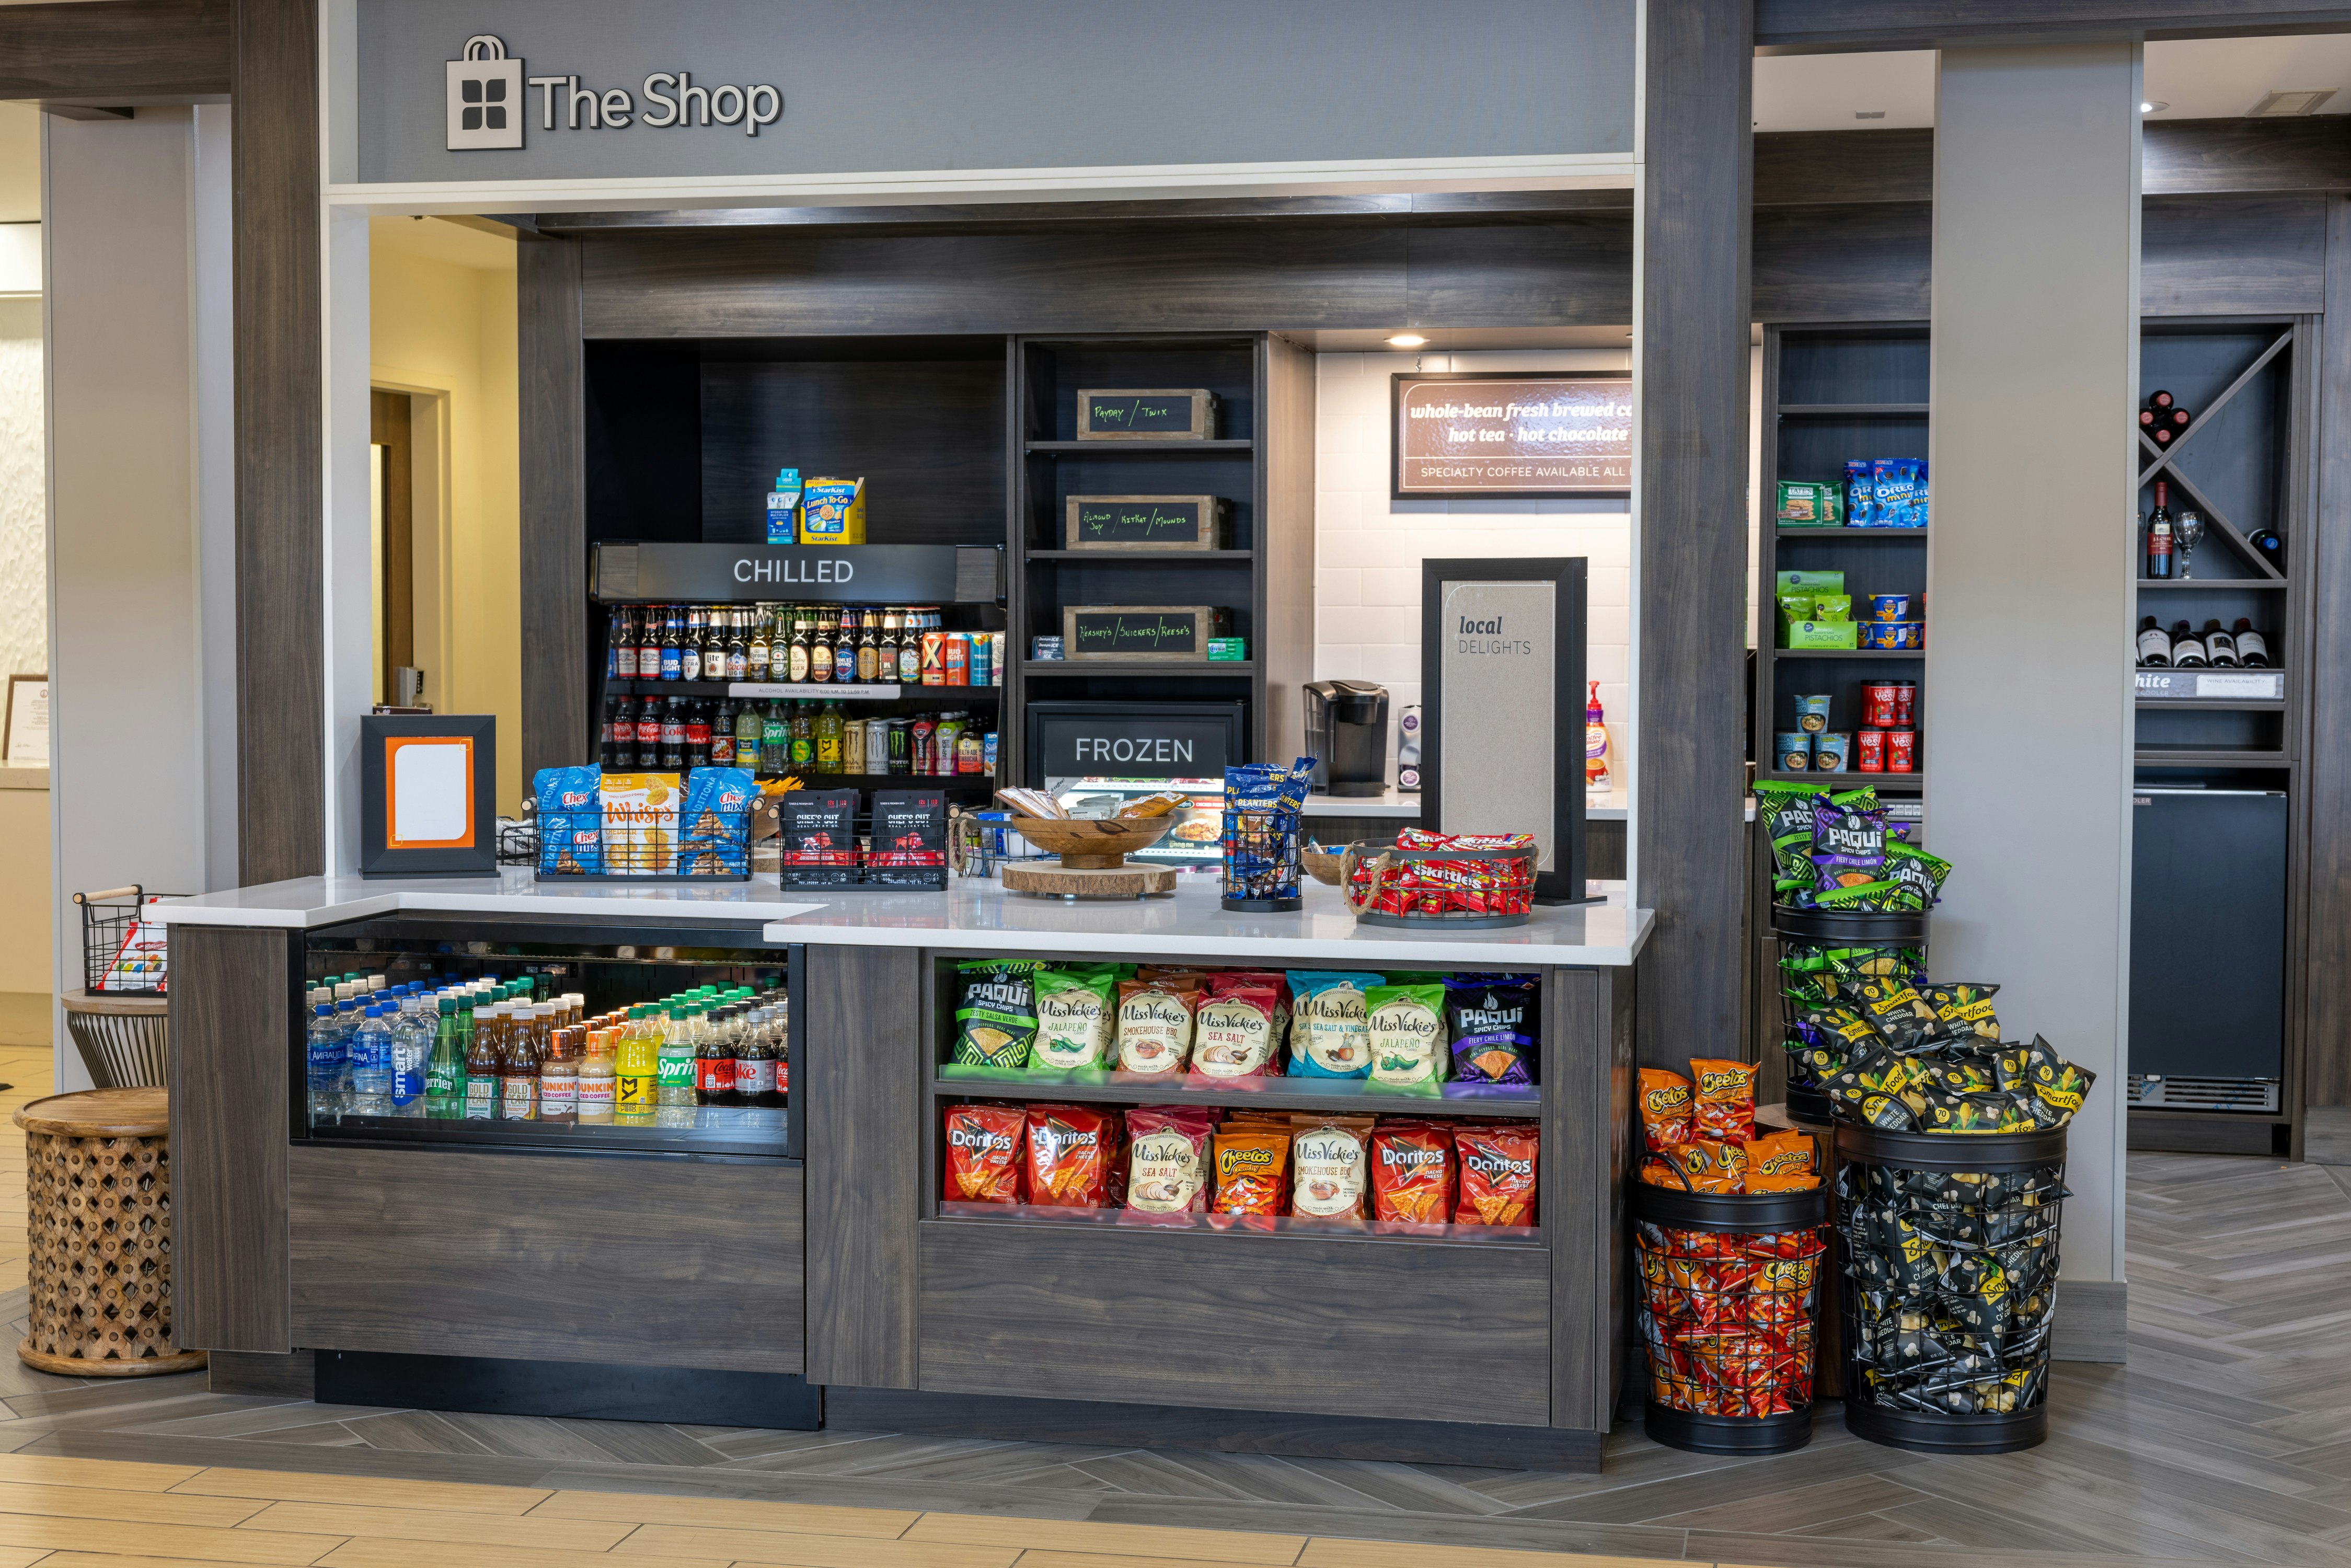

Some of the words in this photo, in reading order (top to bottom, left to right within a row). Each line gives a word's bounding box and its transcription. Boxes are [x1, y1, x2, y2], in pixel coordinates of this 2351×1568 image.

[528, 76, 633, 130] The
[641, 72, 782, 137] Shop
[1095, 406, 1124, 422] PAYDAY
[1142, 407, 1167, 417] TWIX
[1410, 403, 1503, 419] whole-bean
[1503, 402, 1547, 421] fresh
[1552, 402, 1614, 418] brewed
[1448, 427, 1476, 442] hot
[1479, 430, 1505, 442] tea
[1517, 427, 1545, 442] hot
[1548, 426, 1629, 442] chocolate
[1421, 467, 1483, 477] SPECIALTY
[1487, 467, 1532, 477] COFFEE
[1536, 467, 1599, 476] AVAILABLE
[1604, 467, 1626, 476] ALL
[1876, 484, 1915, 497] OREO
[1886, 491, 1911, 503] mini
[734, 559, 854, 583] CHILLED
[1459, 616, 1503, 635] local
[1459, 640, 1531, 655] DELIGHTS
[1076, 738, 1193, 763] FROZEN
[1238, 798, 1278, 809] PLANTERS
[1841, 846, 1855, 855] SPICY
[1855, 847, 1872, 856] CHIPS
[1836, 856, 1848, 864] FIERY
[1849, 857, 1861, 866] CHILE
[977, 999, 996, 1009] SPICY
[996, 1002, 1013, 1012] CHIPS
[1038, 999, 1067, 1018] Miss
[1065, 999, 1102, 1022] Vickie's
[1886, 1008, 1907, 1018] WHITE
[970, 1009, 985, 1018] ZESTY
[985, 1011, 1002, 1022] SALSA
[1002, 1014, 1019, 1025] VERDE
[1121, 1004, 1149, 1023] Miss
[1146, 1001, 1186, 1027] Vickie's
[1885, 1011, 1915, 1023] CHEDDAR
[1048, 1021, 1088, 1033] JALAPEÑO
[1197, 1011, 1226, 1029] Miss
[1224, 1012, 1264, 1035] Vickie's
[1368, 1015, 1399, 1032] Miss
[1395, 1011, 1437, 1037] Vickie's
[1473, 1025, 1491, 1033] SPICY
[1492, 1024, 1512, 1033] CHIPS
[1123, 1025, 1164, 1036] SMOKEHOUSE
[1166, 1027, 1178, 1039] BBQ
[1207, 1031, 1225, 1041] SEA
[1226, 1033, 1246, 1044] SALT
[1468, 1035, 1482, 1045] FIERY
[1483, 1034, 1499, 1044] CHILE
[1380, 1037, 1421, 1049] JALAPEÑO
[469, 1083, 489, 1094] GOLD
[952, 1129, 1012, 1150] Doritos
[1132, 1143, 1160, 1161] Miss
[1158, 1143, 1192, 1165] Vickie's
[1296, 1143, 1322, 1161] Miss
[1318, 1140, 1359, 1165] Vickie's
[1382, 1149, 1446, 1165] Doritos
[1220, 1148, 1273, 1176] Cheetos
[1468, 1156, 1532, 1173] Doritos
[1142, 1168, 1159, 1178] SEA
[1159, 1168, 1178, 1179] SALT
[1297, 1166, 1339, 1175] SMOKEHOUSE
[1339, 1166, 1352, 1178] BBQ
